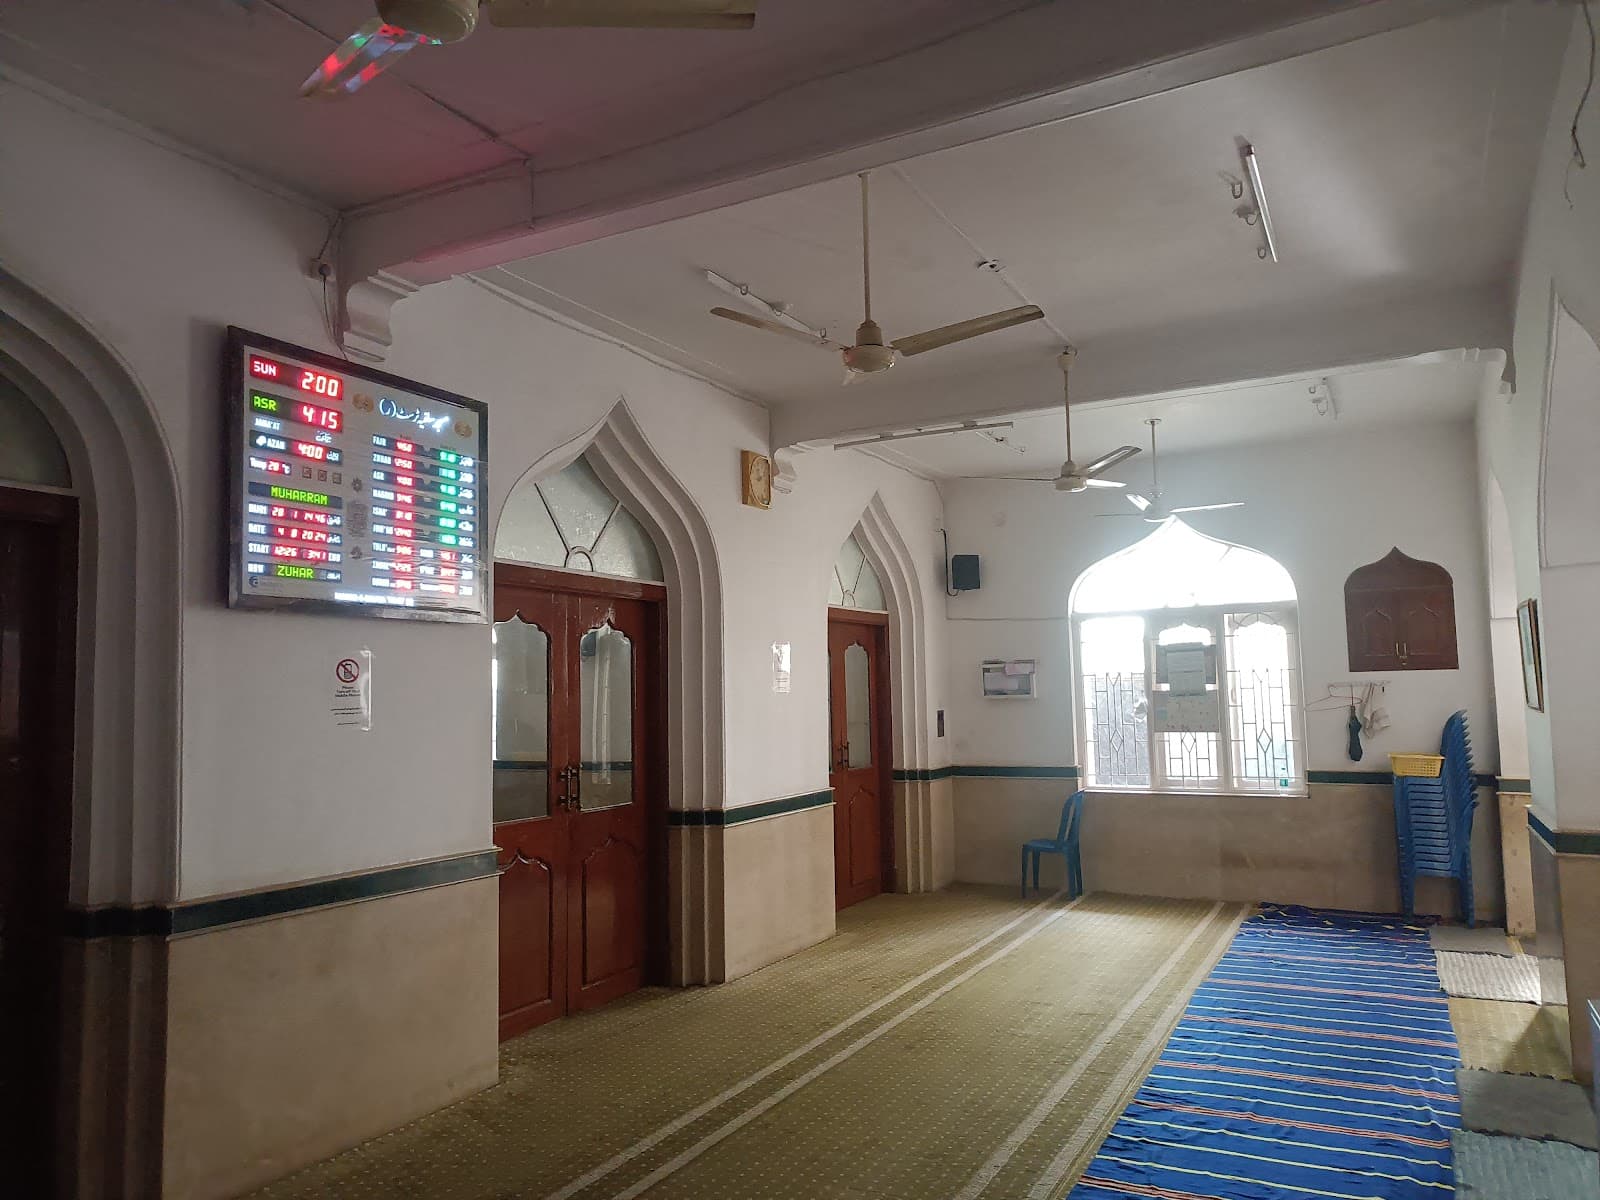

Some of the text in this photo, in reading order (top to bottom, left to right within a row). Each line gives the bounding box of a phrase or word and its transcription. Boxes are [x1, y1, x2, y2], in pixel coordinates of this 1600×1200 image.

[253, 361, 277, 377] SUN
[253, 395, 277, 411] ASR
[271, 486, 328, 505] MUHARRAM
[248, 522, 267, 535] DATE
[248, 543, 270, 554] START
[277, 565, 314, 579] ZUHAR
